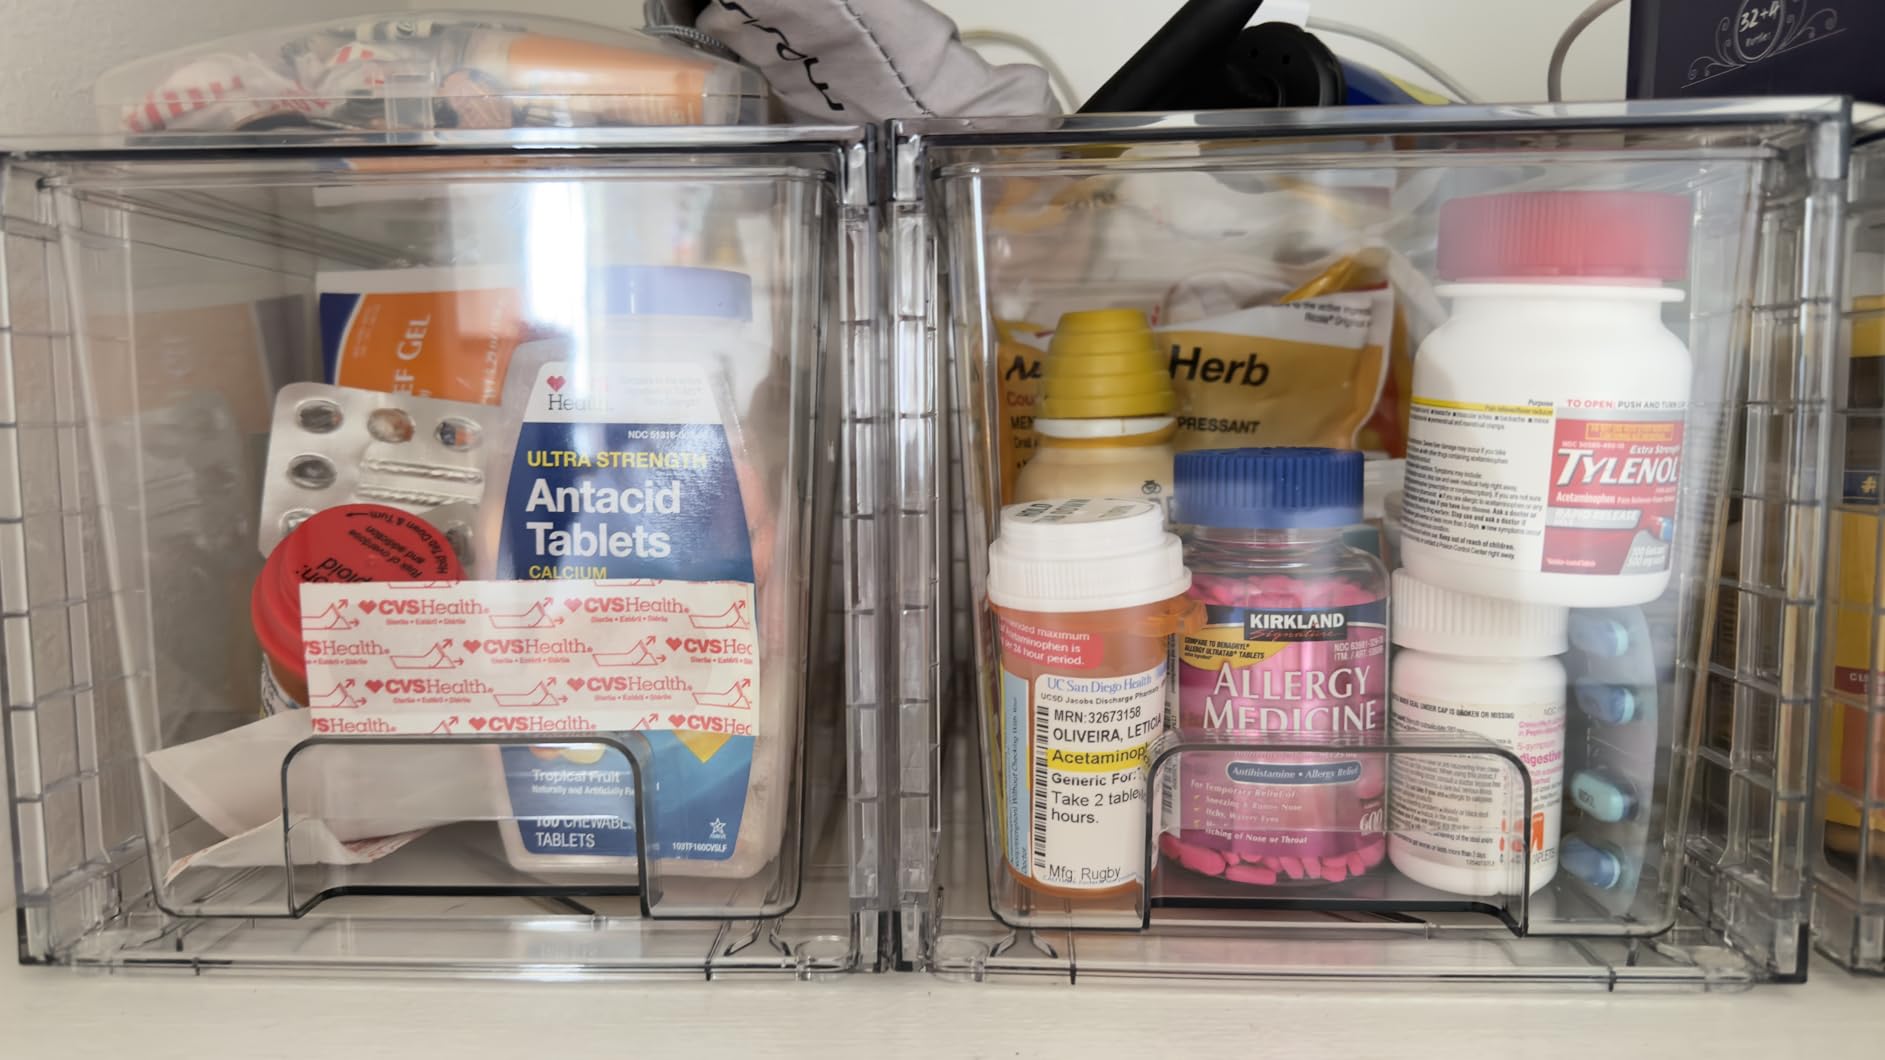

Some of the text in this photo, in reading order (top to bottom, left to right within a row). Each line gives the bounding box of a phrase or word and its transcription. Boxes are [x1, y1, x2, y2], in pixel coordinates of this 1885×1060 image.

[396, 314, 432, 361] GEL
[1169, 345, 1270, 387] Herb
[1567, 399, 1581, 408] TO
[1617, 400, 1641, 409] PUSH
[1643, 401, 1660, 409] AND
[1176, 417, 1262, 434] PRESSANT
[628, 430, 648, 439] NDC
[527, 451, 708, 469] ULTRA STRENGTH
[1557, 448, 1679, 486] TYLENOL
[525, 478, 681, 514] Antacid
[368, 511, 393, 523] Turn
[406, 521, 432, 542] Down
[526, 522, 672, 558] Tablets
[347, 529, 422, 578] Risk of overdose
[365, 526, 426, 565] and addiction
[436, 555, 449, 575] Hold
[529, 565, 607, 580] CALCIUM
[1250, 613, 1345, 630] KIRKLAND
[1036, 628, 1091, 641] maximum
[1071, 643, 1081, 653] is
[1209, 640, 1216, 648] TO
[1023, 647, 1045, 660] hour
[1046, 655, 1085, 667] period.
[1240, 651, 1265, 659] TABLETS
[1046, 675, 1152, 694] UC San Diego Health
[1213, 662, 1371, 701] ALLERGY
[1040, 692, 1063, 703] UCSD
[1096, 695, 1134, 705] Discharge
[1054, 705, 1141, 723] MRN:32673158
[1203, 697, 1377, 733] MEDICINE
[1437, 706, 1449, 714] CAP
[1052, 712, 1163, 744] OLIVEIRA, LETICIA
[531, 768, 621, 783] Tropical Fruit
[1051, 771, 1137, 787] Generic For:
[1232, 765, 1359, 779] Antihistamine Allergy Relief
[1050, 791, 1091, 806] Take
[1094, 792, 1104, 806] 2
[563, 817, 634, 830] CHEWABL
[1051, 809, 1099, 824] hours.
[535, 832, 595, 849] TABLETS
[1234, 832, 1244, 840] of
[1245, 832, 1266, 842] Nose
[1280, 835, 1308, 844] Throat
[1081, 866, 1121, 882] Rugby
